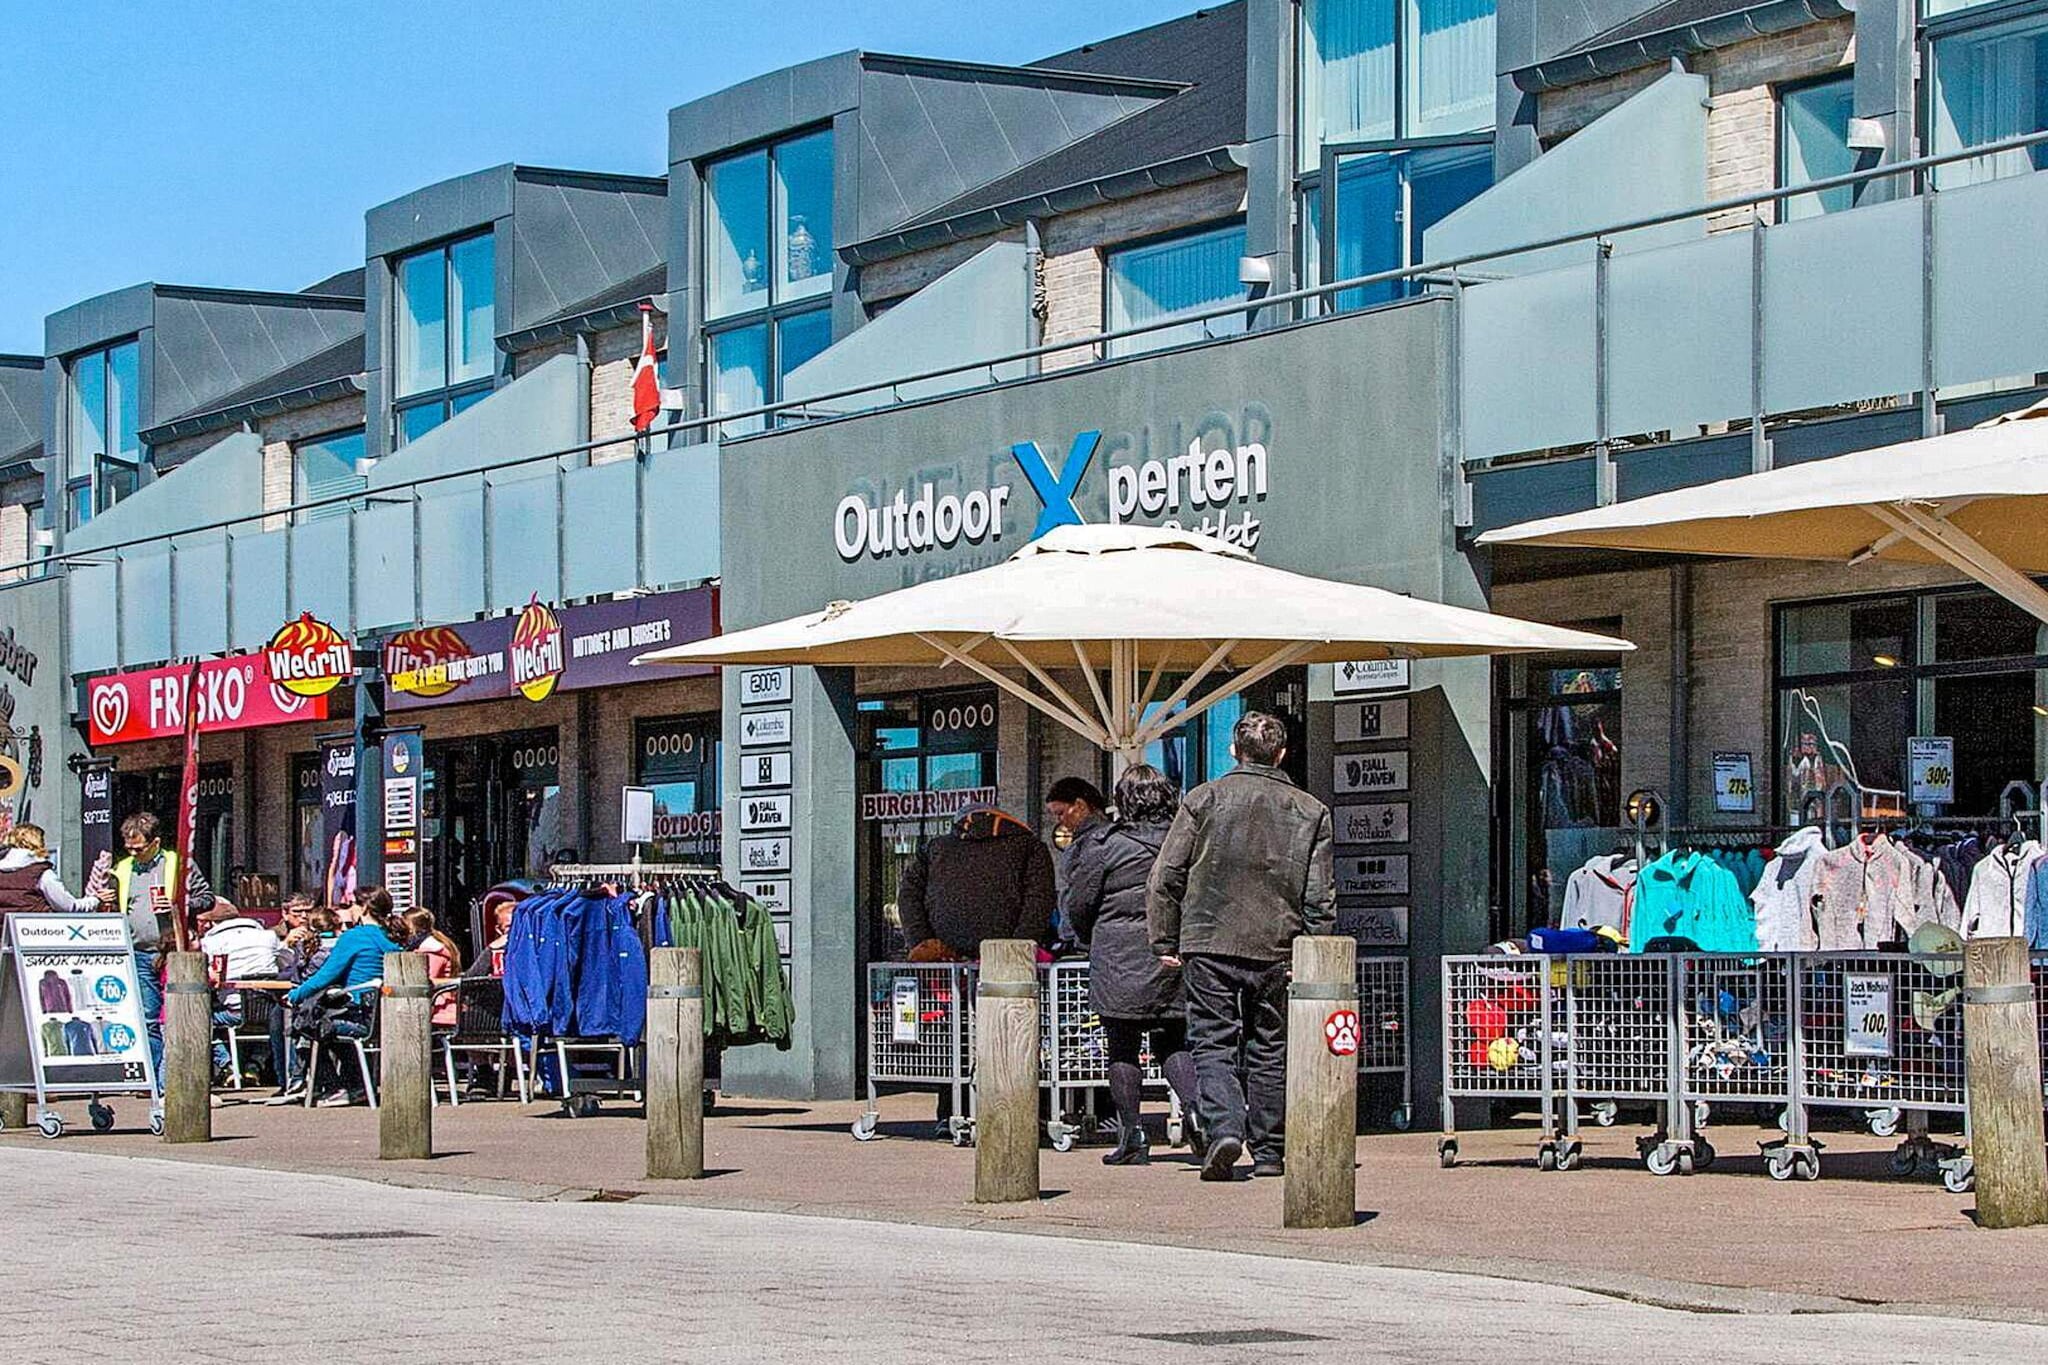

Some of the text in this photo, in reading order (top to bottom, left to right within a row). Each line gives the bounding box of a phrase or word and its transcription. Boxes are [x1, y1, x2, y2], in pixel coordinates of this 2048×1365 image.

[834, 483, 1010, 563] Outdoor
[1162, 509, 1260, 548] tlet
[612, 627, 630, 650] AND
[268, 645, 352, 680] WeGrill
[447, 660, 465, 681] THAT
[466, 655, 487, 678] SUITS
[488, 651, 504, 673] YOU
[511, 631, 563, 685] WeGrill
[864, 791, 937, 819] BURGER
[21, 927, 64, 936] Outdoor
